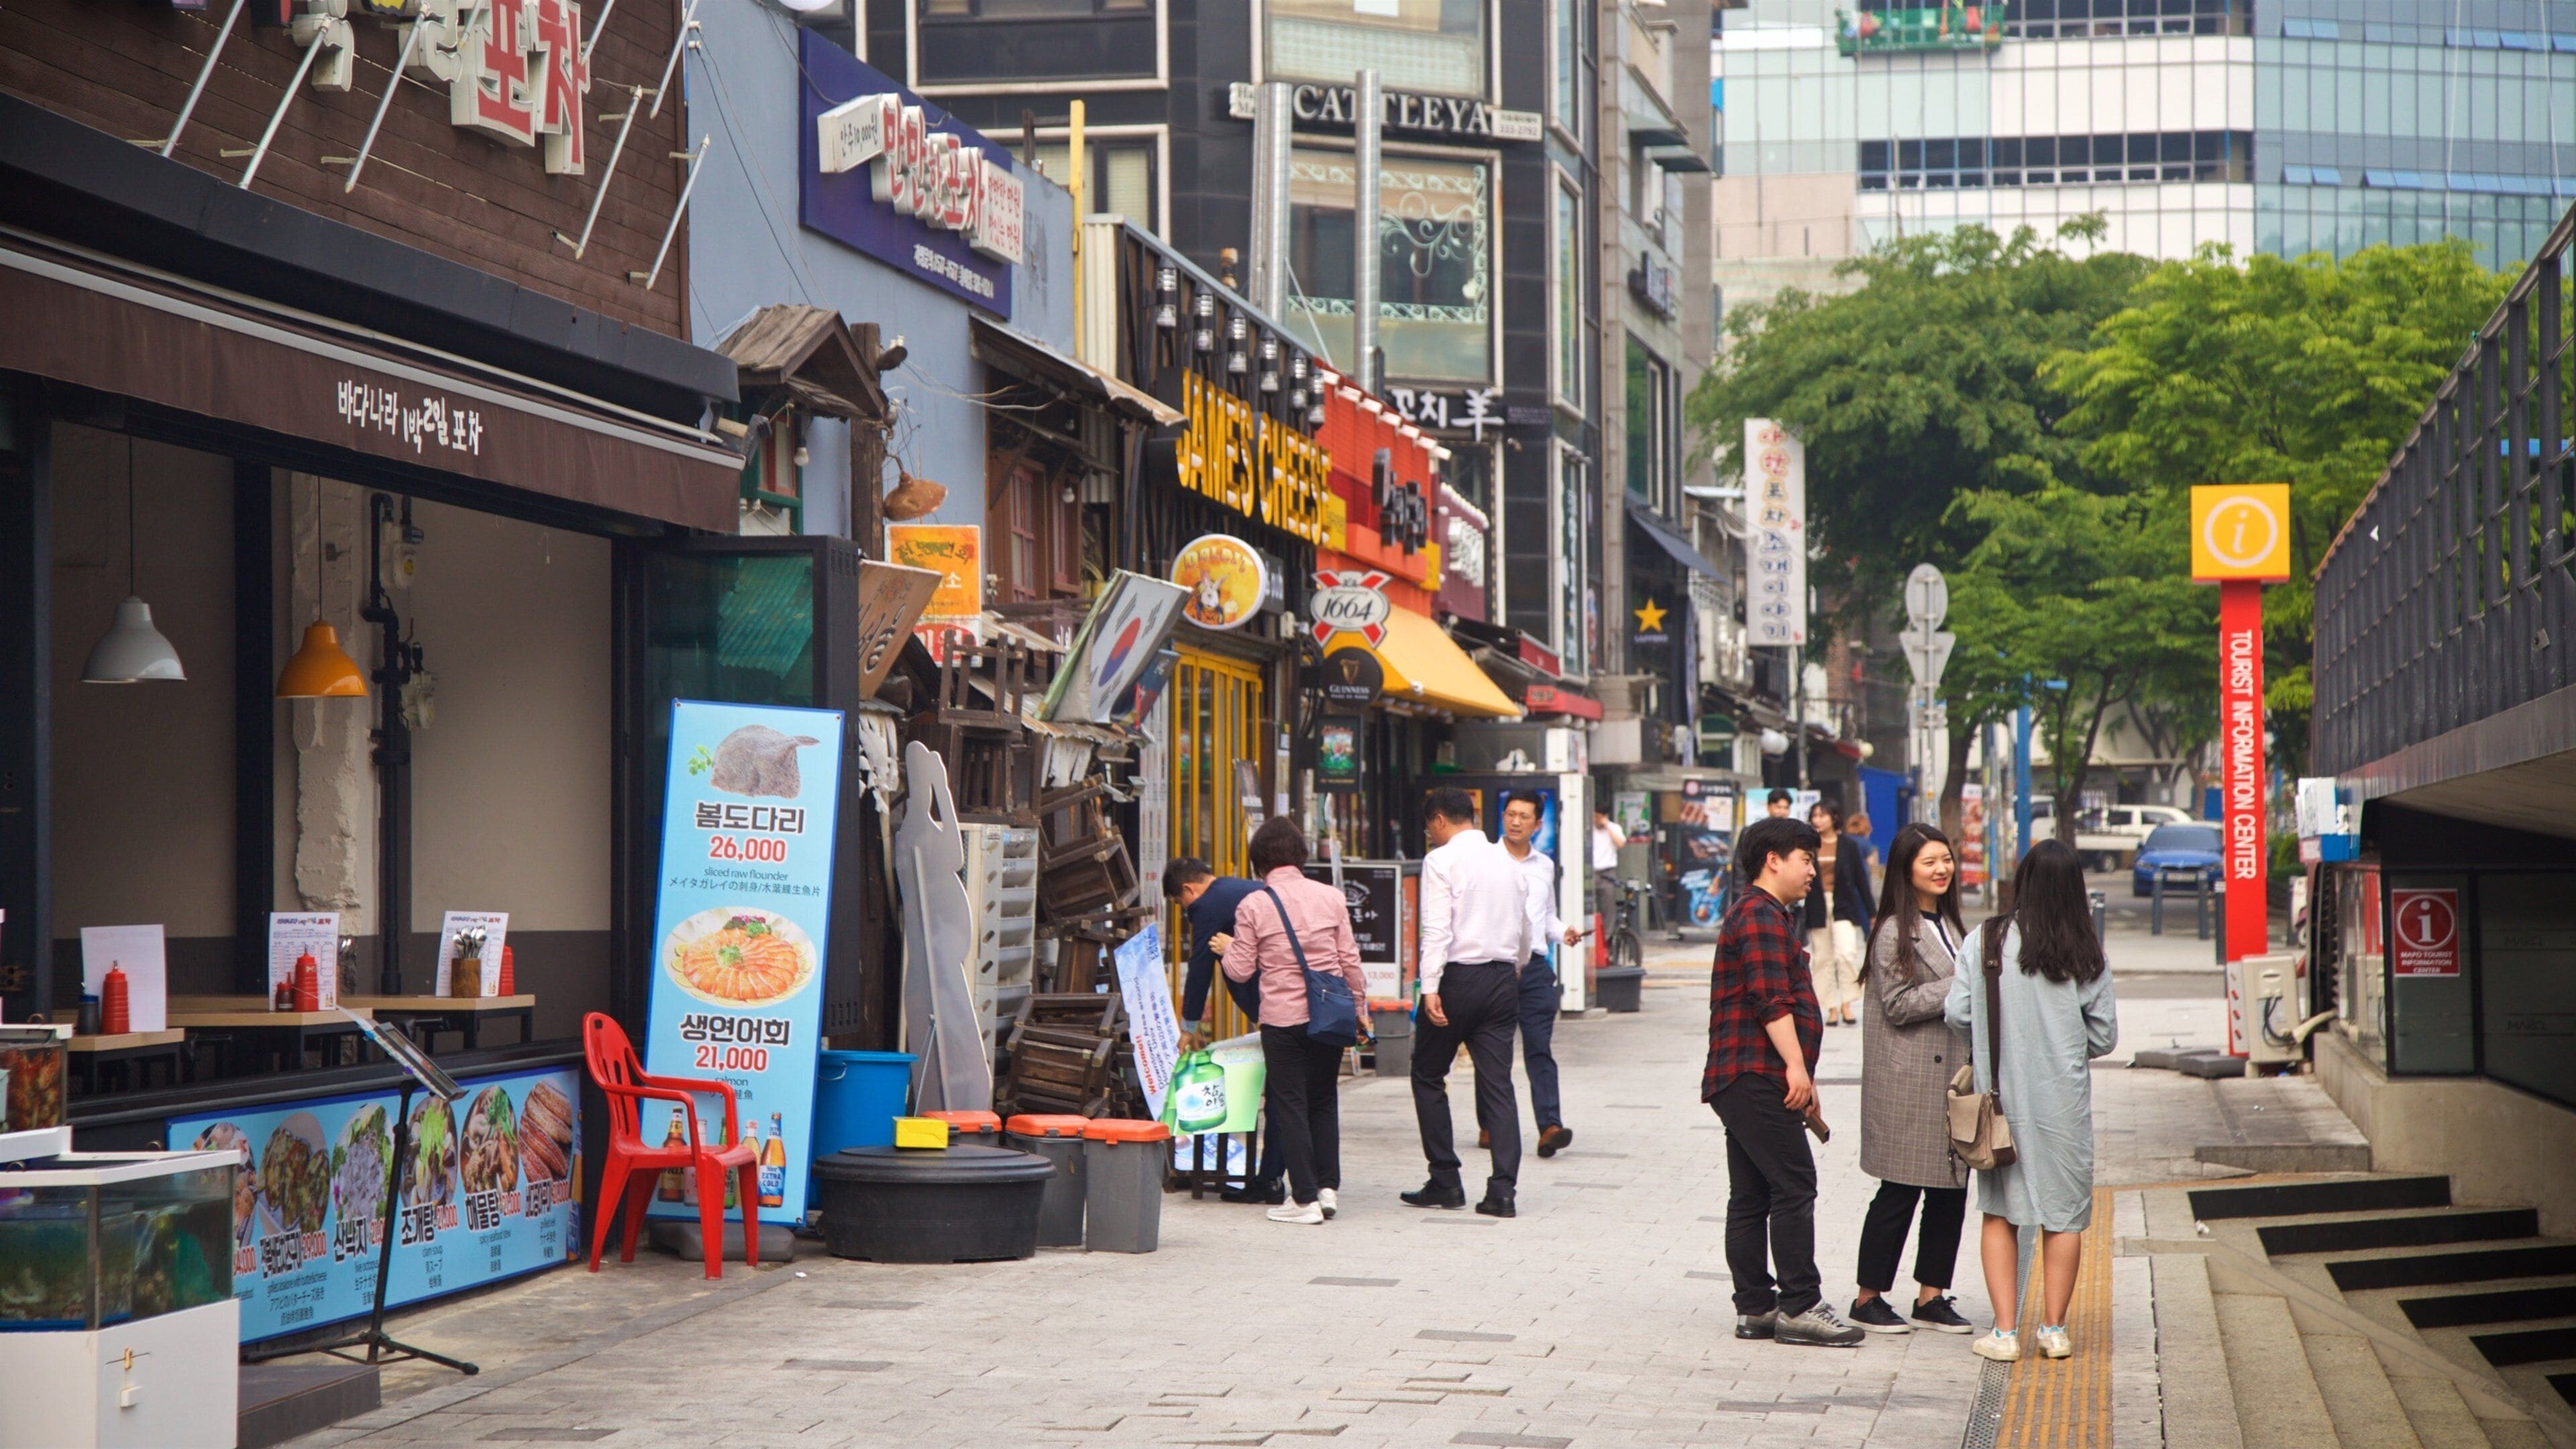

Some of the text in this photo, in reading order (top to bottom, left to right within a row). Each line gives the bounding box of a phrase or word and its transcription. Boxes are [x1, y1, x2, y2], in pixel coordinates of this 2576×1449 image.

[337, 380, 398, 435] 바다나라
[452, 410, 483, 456] 포차
[1175, 366, 1254, 519] JAMES
[1258, 411, 1334, 546] CHEESE
[1322, 595, 1373, 621] 1664
[1329, 684, 1371, 694] GUINNESS
[2230, 629, 2256, 879] TOURIST INFORMATION CENTER
[695, 802, 805, 835] 봄도다리
[710, 835, 786, 862] 26,000
[704, 867, 730, 877] sliced
[749, 869, 789, 881] flounder
[680, 1014, 790, 1046] 생연어회
[1133, 975, 1165, 1089] Downtown Area around
[696, 1045, 767, 1071] 21,000
[1135, 1034, 1157, 1095] Welcome!!
[401, 1204, 435, 1246] 조개탕
[466, 1191, 500, 1231] 해물탕
[333, 1218, 368, 1263] 산낙지
